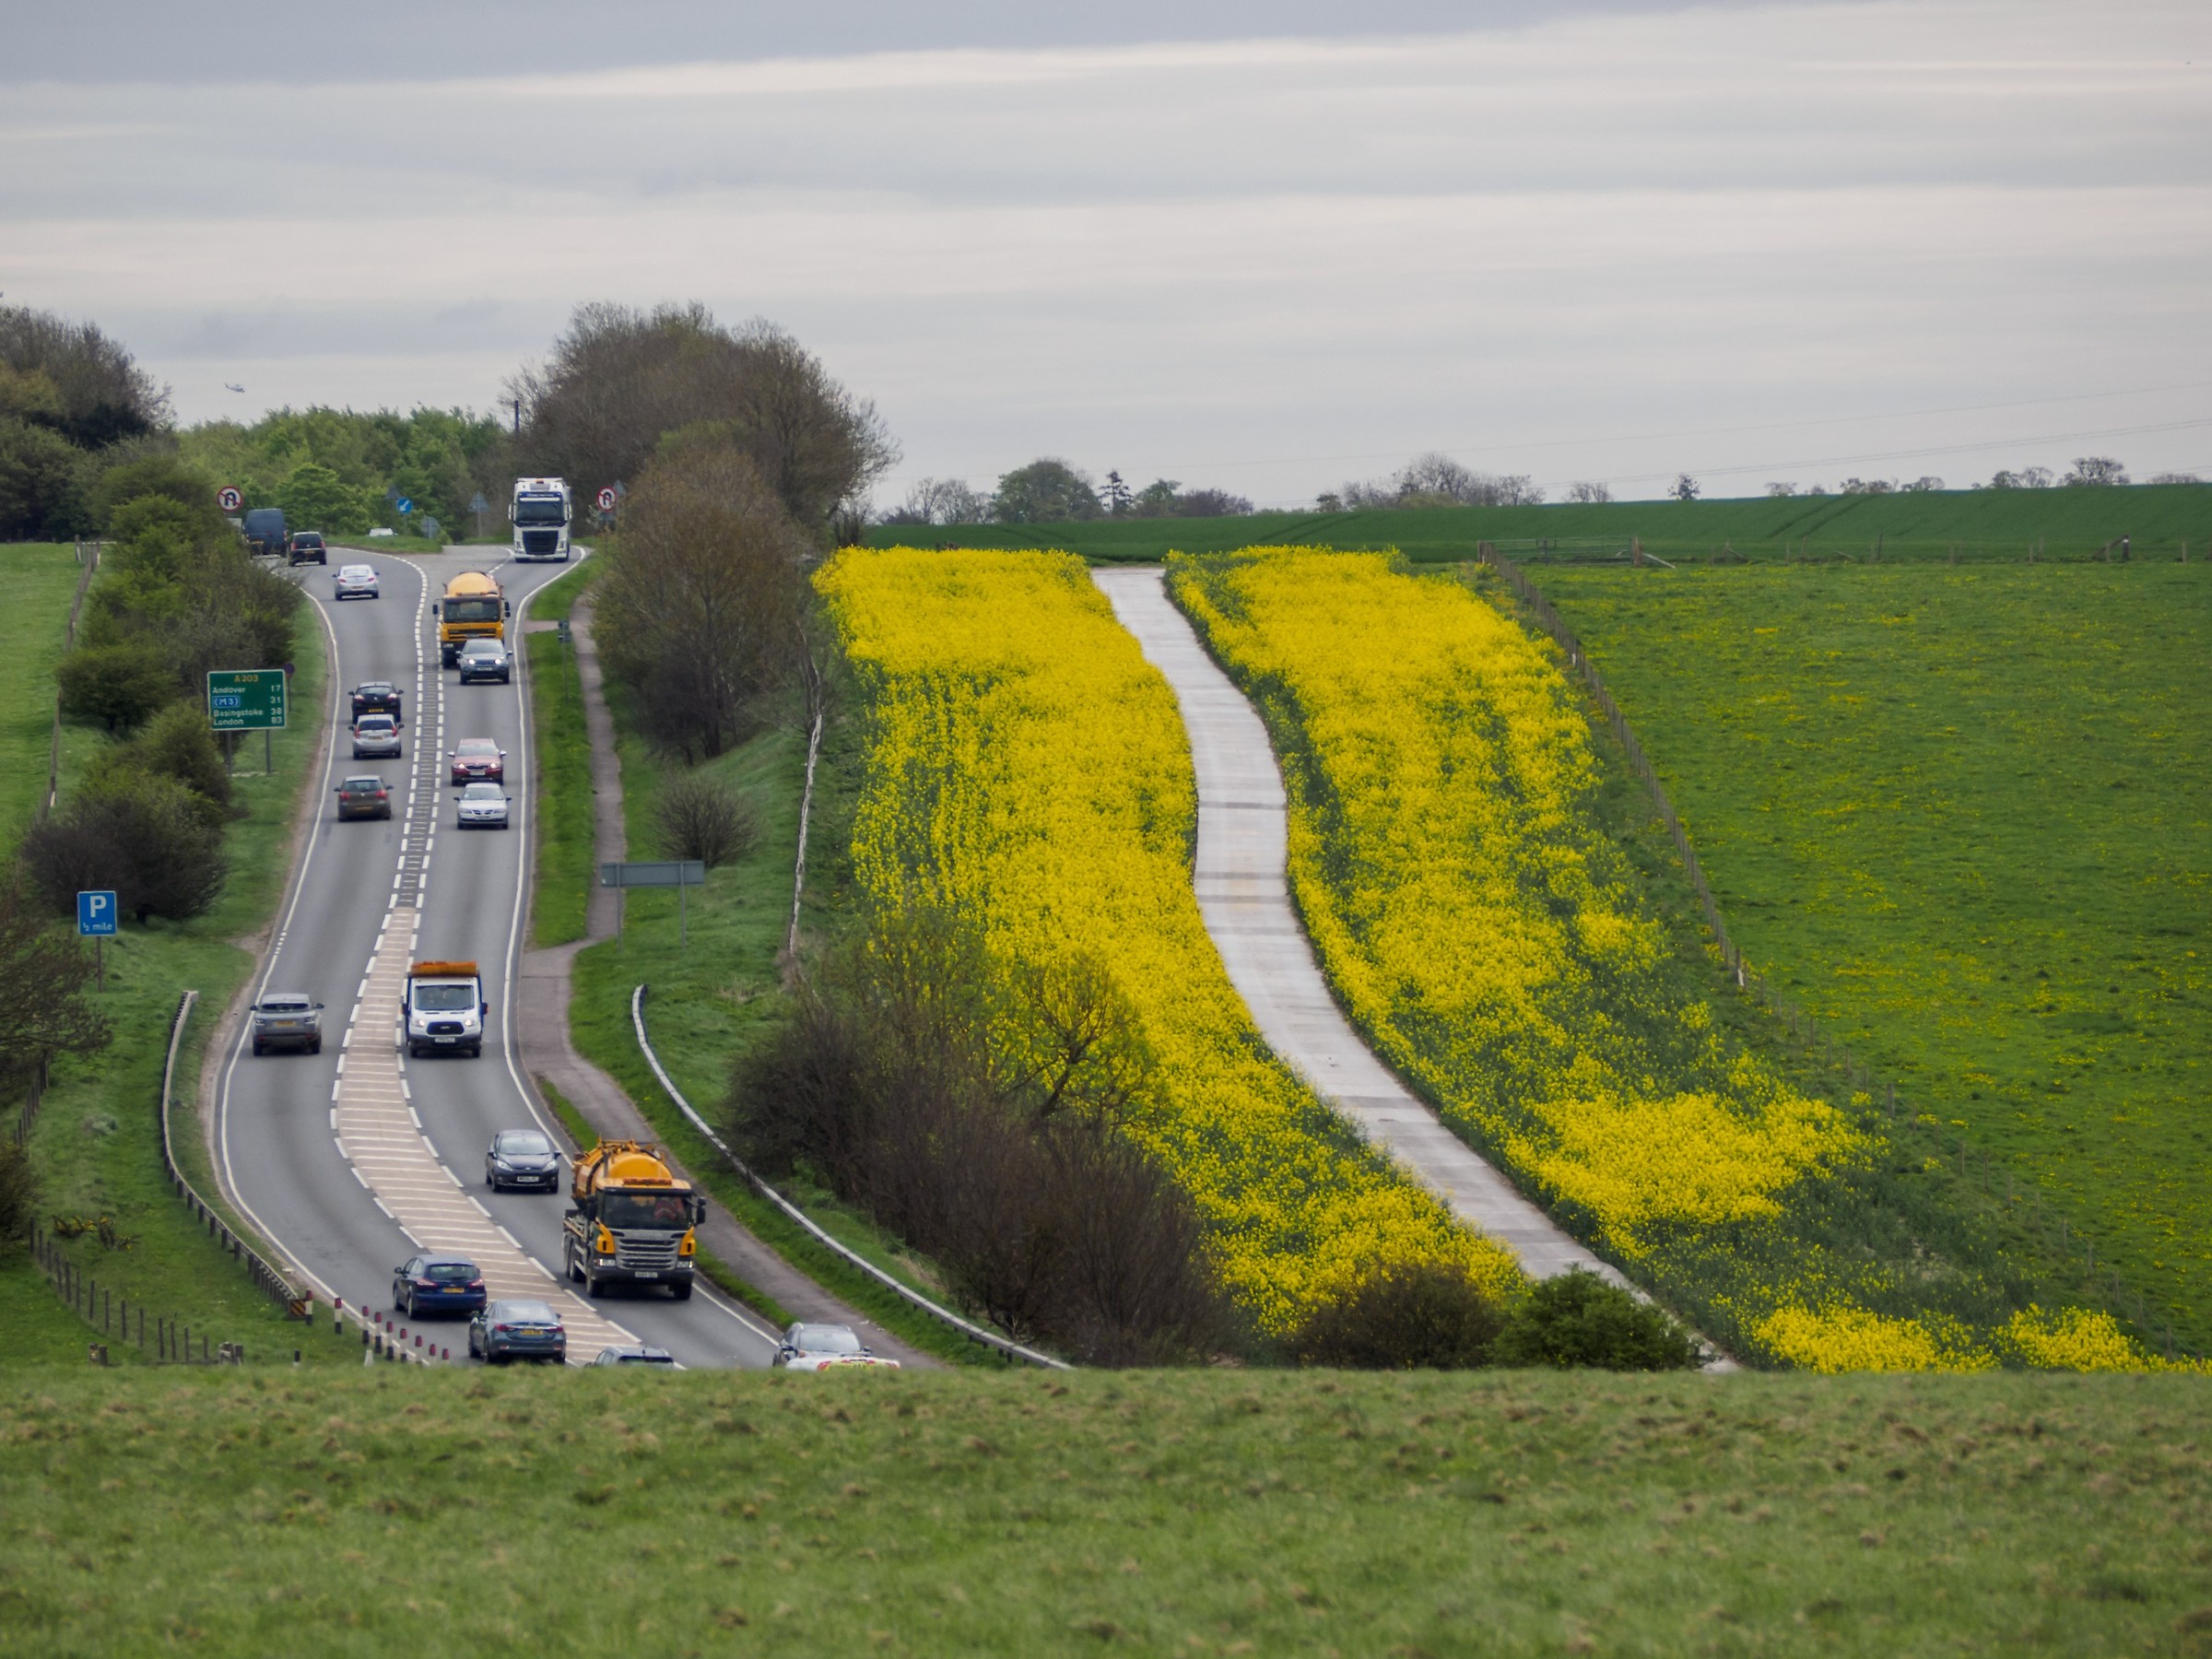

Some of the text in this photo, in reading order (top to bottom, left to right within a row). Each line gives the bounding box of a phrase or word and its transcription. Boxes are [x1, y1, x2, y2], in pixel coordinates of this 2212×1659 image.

[213, 709, 263, 717] Basingstoke
[90, 895, 106, 918] P
[93, 922, 112, 930] mile
